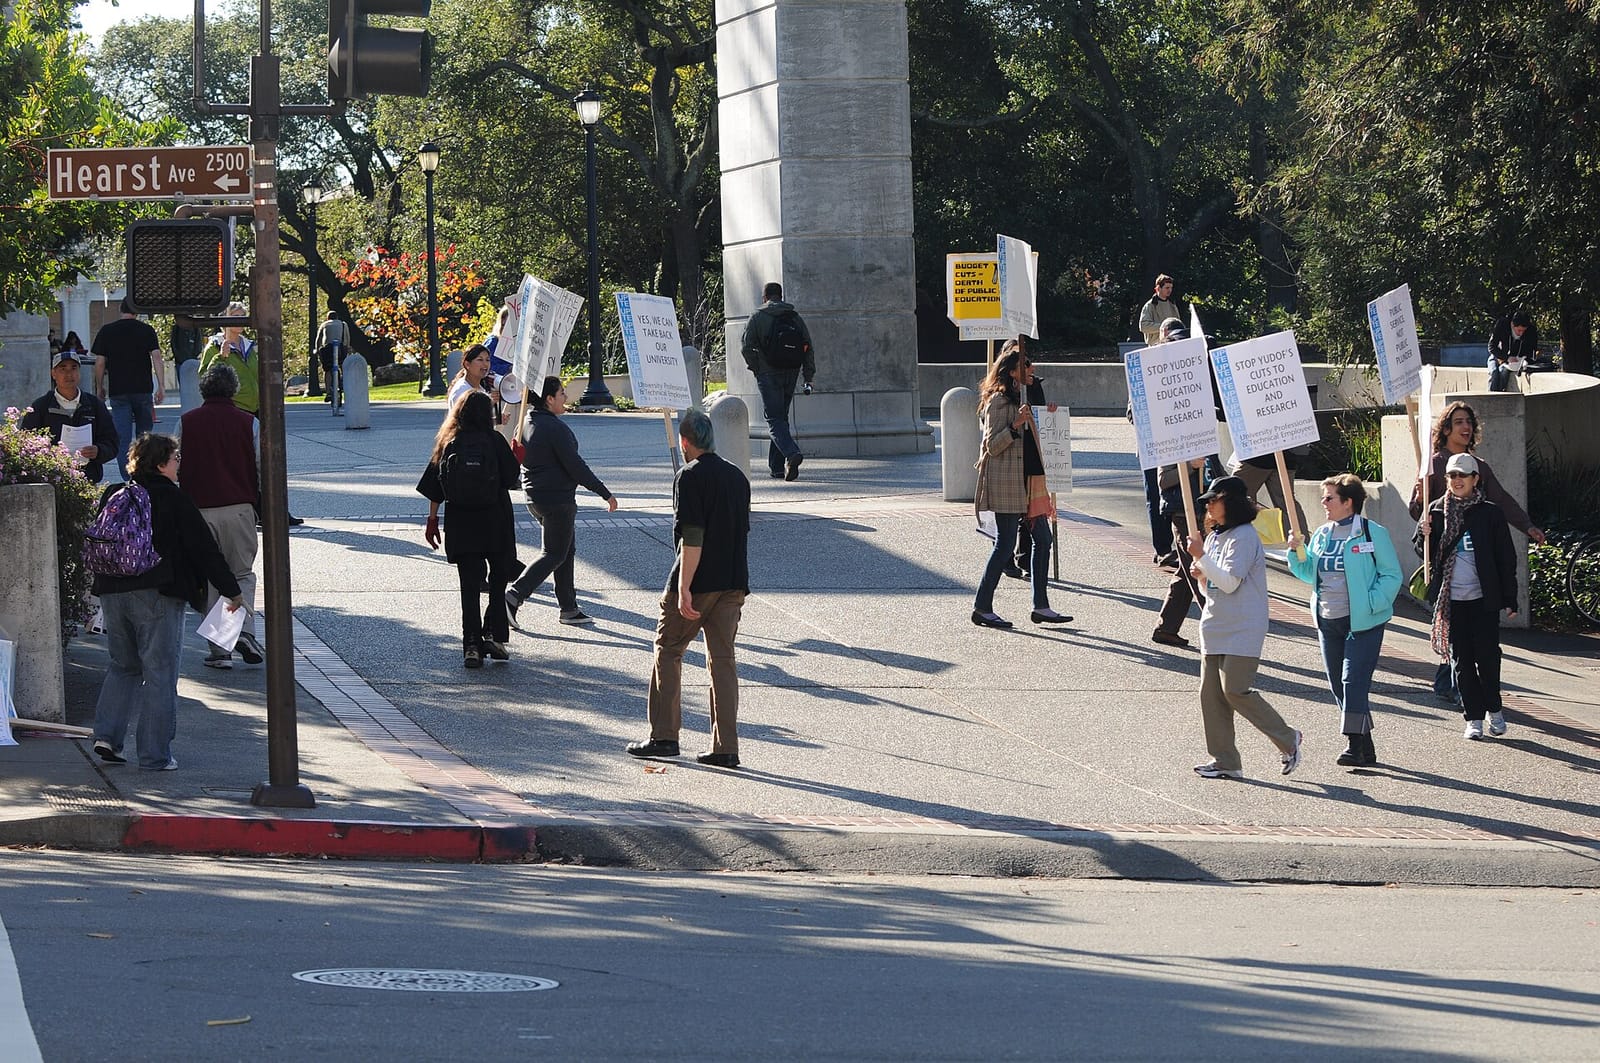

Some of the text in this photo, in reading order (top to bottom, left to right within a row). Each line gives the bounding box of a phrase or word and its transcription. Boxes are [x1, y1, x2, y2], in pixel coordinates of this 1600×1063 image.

[56, 152, 244, 192] Hearst Ave 2500
[1389, 303, 1402, 317] PUBLIC
[638, 315, 673, 327] YES, WE CAN
[1390, 315, 1405, 330] SERVICE
[643, 328, 673, 339] TAKE BACK
[655, 342, 667, 352] OUR
[1396, 338, 1409, 352] PUBLIC
[646, 355, 678, 366] UNIVERSITY
[1127, 352, 1140, 361] UP
[1213, 349, 1226, 358] UP
[1215, 355, 1228, 364] TE
[1235, 348, 1294, 371] STOP YUDOF'S
[1396, 349, 1412, 366] PLUNDER
[1129, 368, 1142, 376] UP
[1147, 356, 1203, 376] STOP YUDOF'S
[1217, 363, 1230, 372] UP
[1250, 364, 1284, 380] CUTS TO
[1161, 371, 1194, 386] CUTS TO
[1219, 370, 1231, 378] TE
[1220, 377, 1233, 385] UP
[1132, 382, 1144, 390] UP
[1222, 383, 1234, 391] TE
[1246, 374, 1295, 394] EDUCATION
[1156, 383, 1202, 401] EDUCATION
[1223, 390, 1235, 399] UP
[1265, 390, 1283, 402] AND
[1173, 399, 1190, 410] AND
[1256, 400, 1298, 417] RESEARCH
[1164, 409, 1204, 426] RESEARCH
[1240, 417, 1313, 440] University Professional
[1146, 428, 1216, 449] University Professional
[1250, 432, 1279, 446] Technical
[1155, 442, 1184, 456] Technical
[1186, 436, 1217, 449] Employees
[1320, 555, 1345, 571] TE
